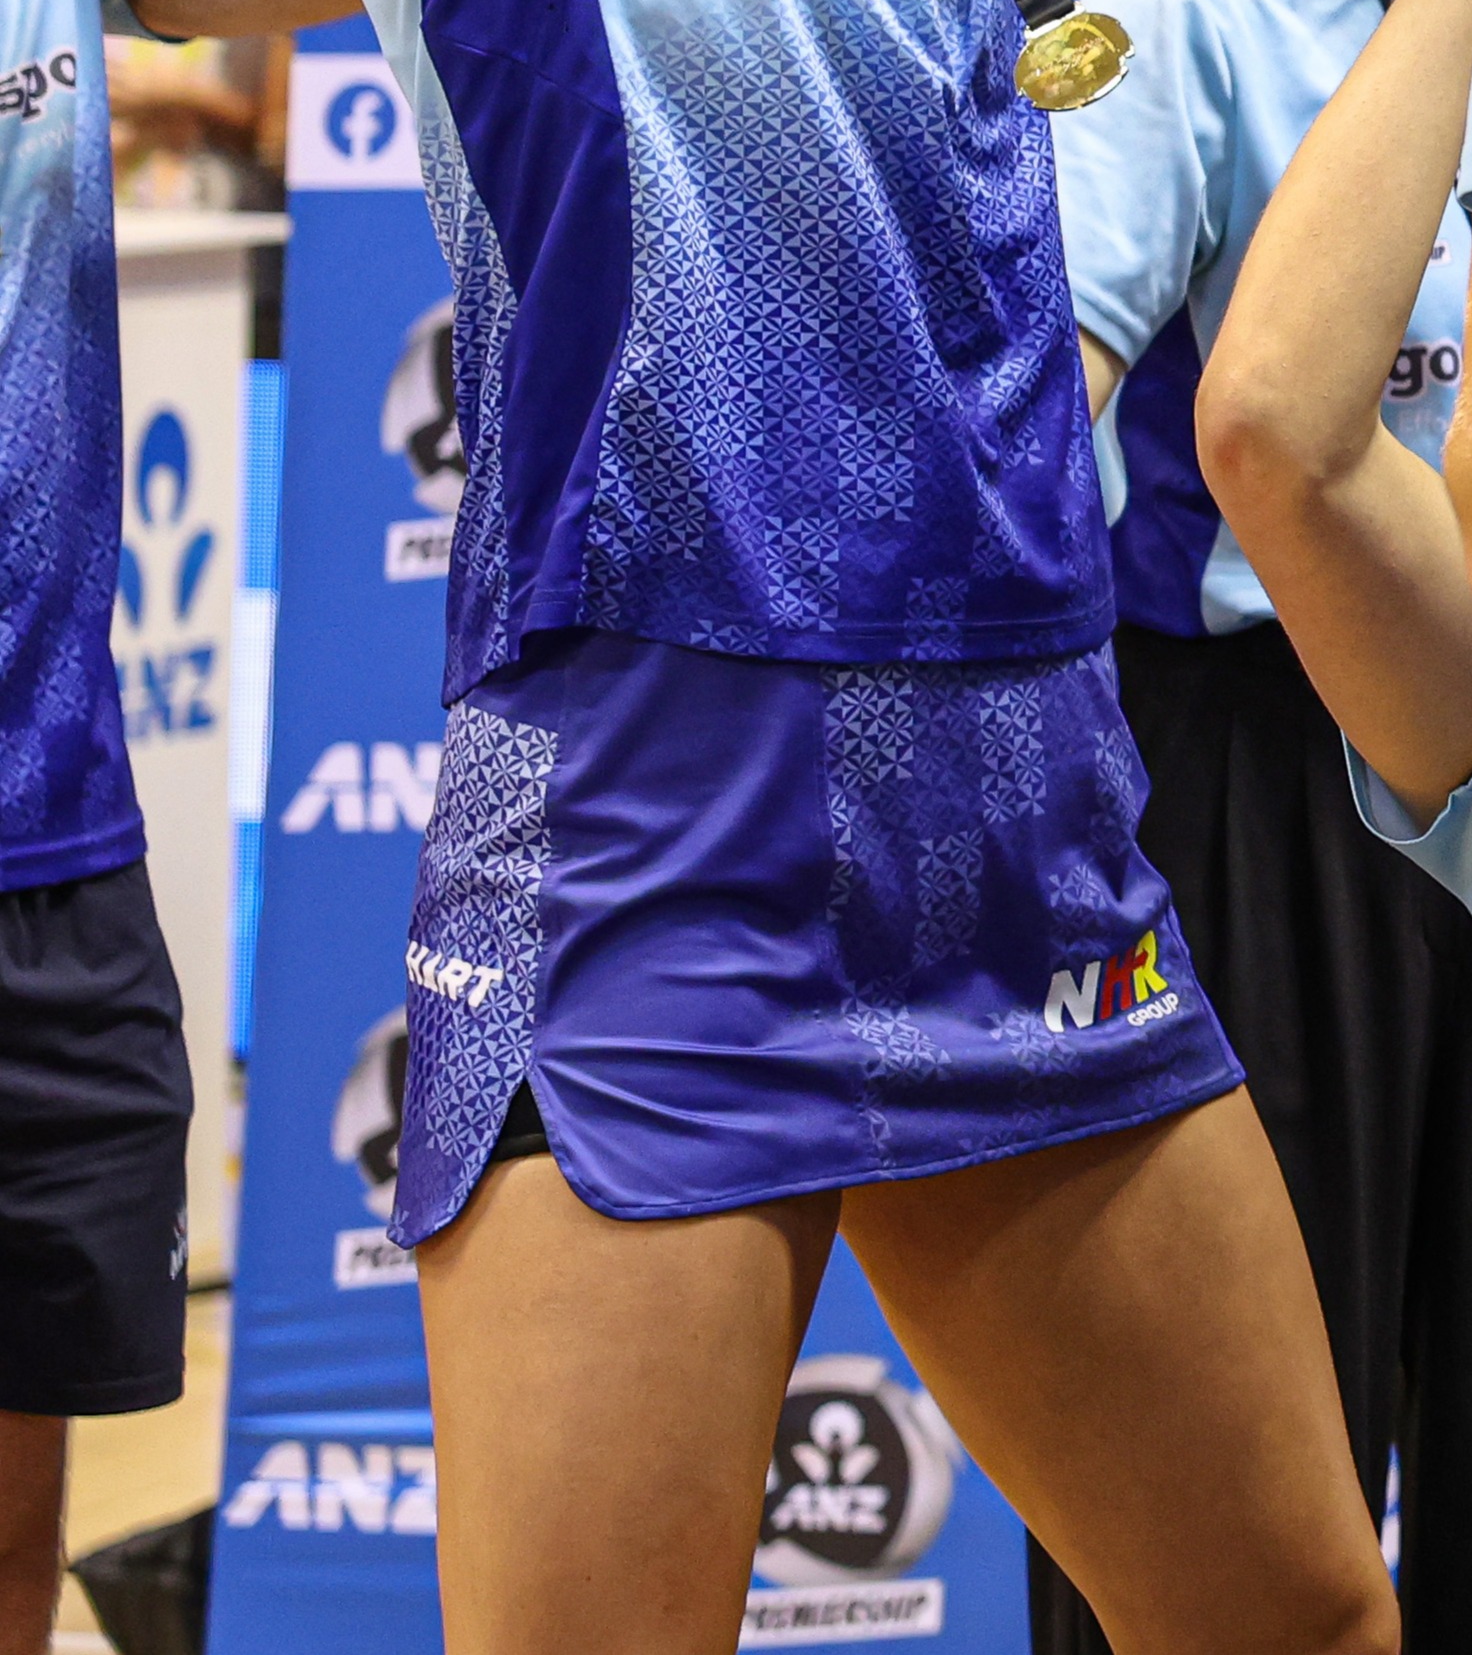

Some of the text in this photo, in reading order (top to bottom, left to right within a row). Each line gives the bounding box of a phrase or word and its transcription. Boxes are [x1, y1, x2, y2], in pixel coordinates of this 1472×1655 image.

[281, 743, 447, 834] AN
[1043, 929, 1168, 1032] NHR
[1127, 992, 1179, 1028] GROUP
